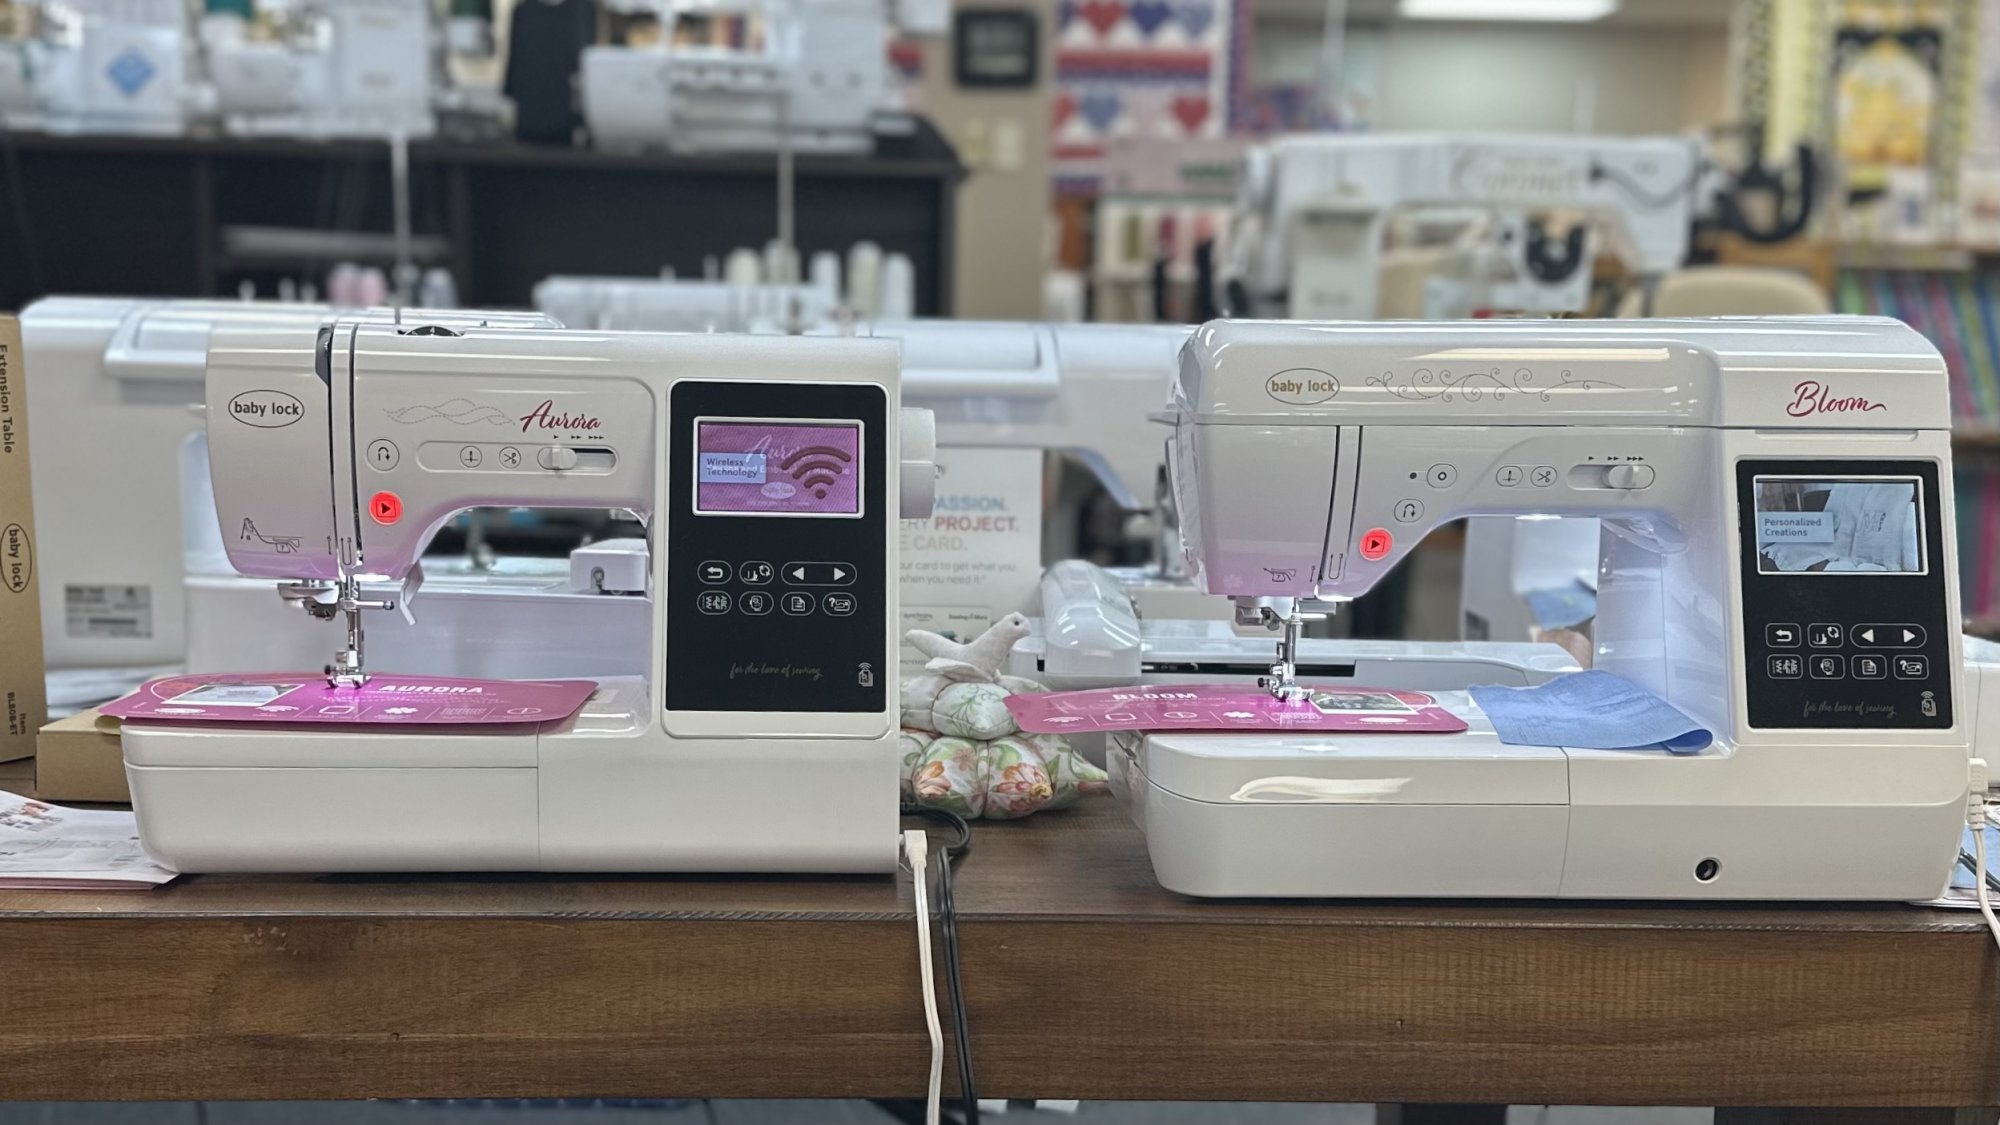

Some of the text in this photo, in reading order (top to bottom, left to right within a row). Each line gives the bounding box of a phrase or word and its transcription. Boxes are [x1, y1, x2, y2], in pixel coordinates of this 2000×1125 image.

[1271, 379, 1335, 395] baby lock
[1786, 380, 1887, 418] Bloom
[234, 400, 300, 418] baby lock
[520, 399, 601, 433] Aurora
[2, 416, 15, 454] Table
[706, 457, 744, 467] Wireless
[706, 466, 759, 479] Technology
[934, 516, 1020, 533] PROJECT.
[1763, 517, 1822, 527] Personalized
[1764, 528, 1808, 537] Creations
[913, 534, 968, 551] CARD.
[9, 528, 24, 589] baby lock
[916, 561, 938, 571] card
[940, 561, 952, 571] to
[927, 576, 945, 586] you
[947, 575, 971, 585] need
[730, 662, 824, 681] for the love of sewing
[378, 684, 483, 694] AURORA
[1111, 692, 1198, 701] BLOOM
[1803, 700, 1898, 719] for the love of sewing
